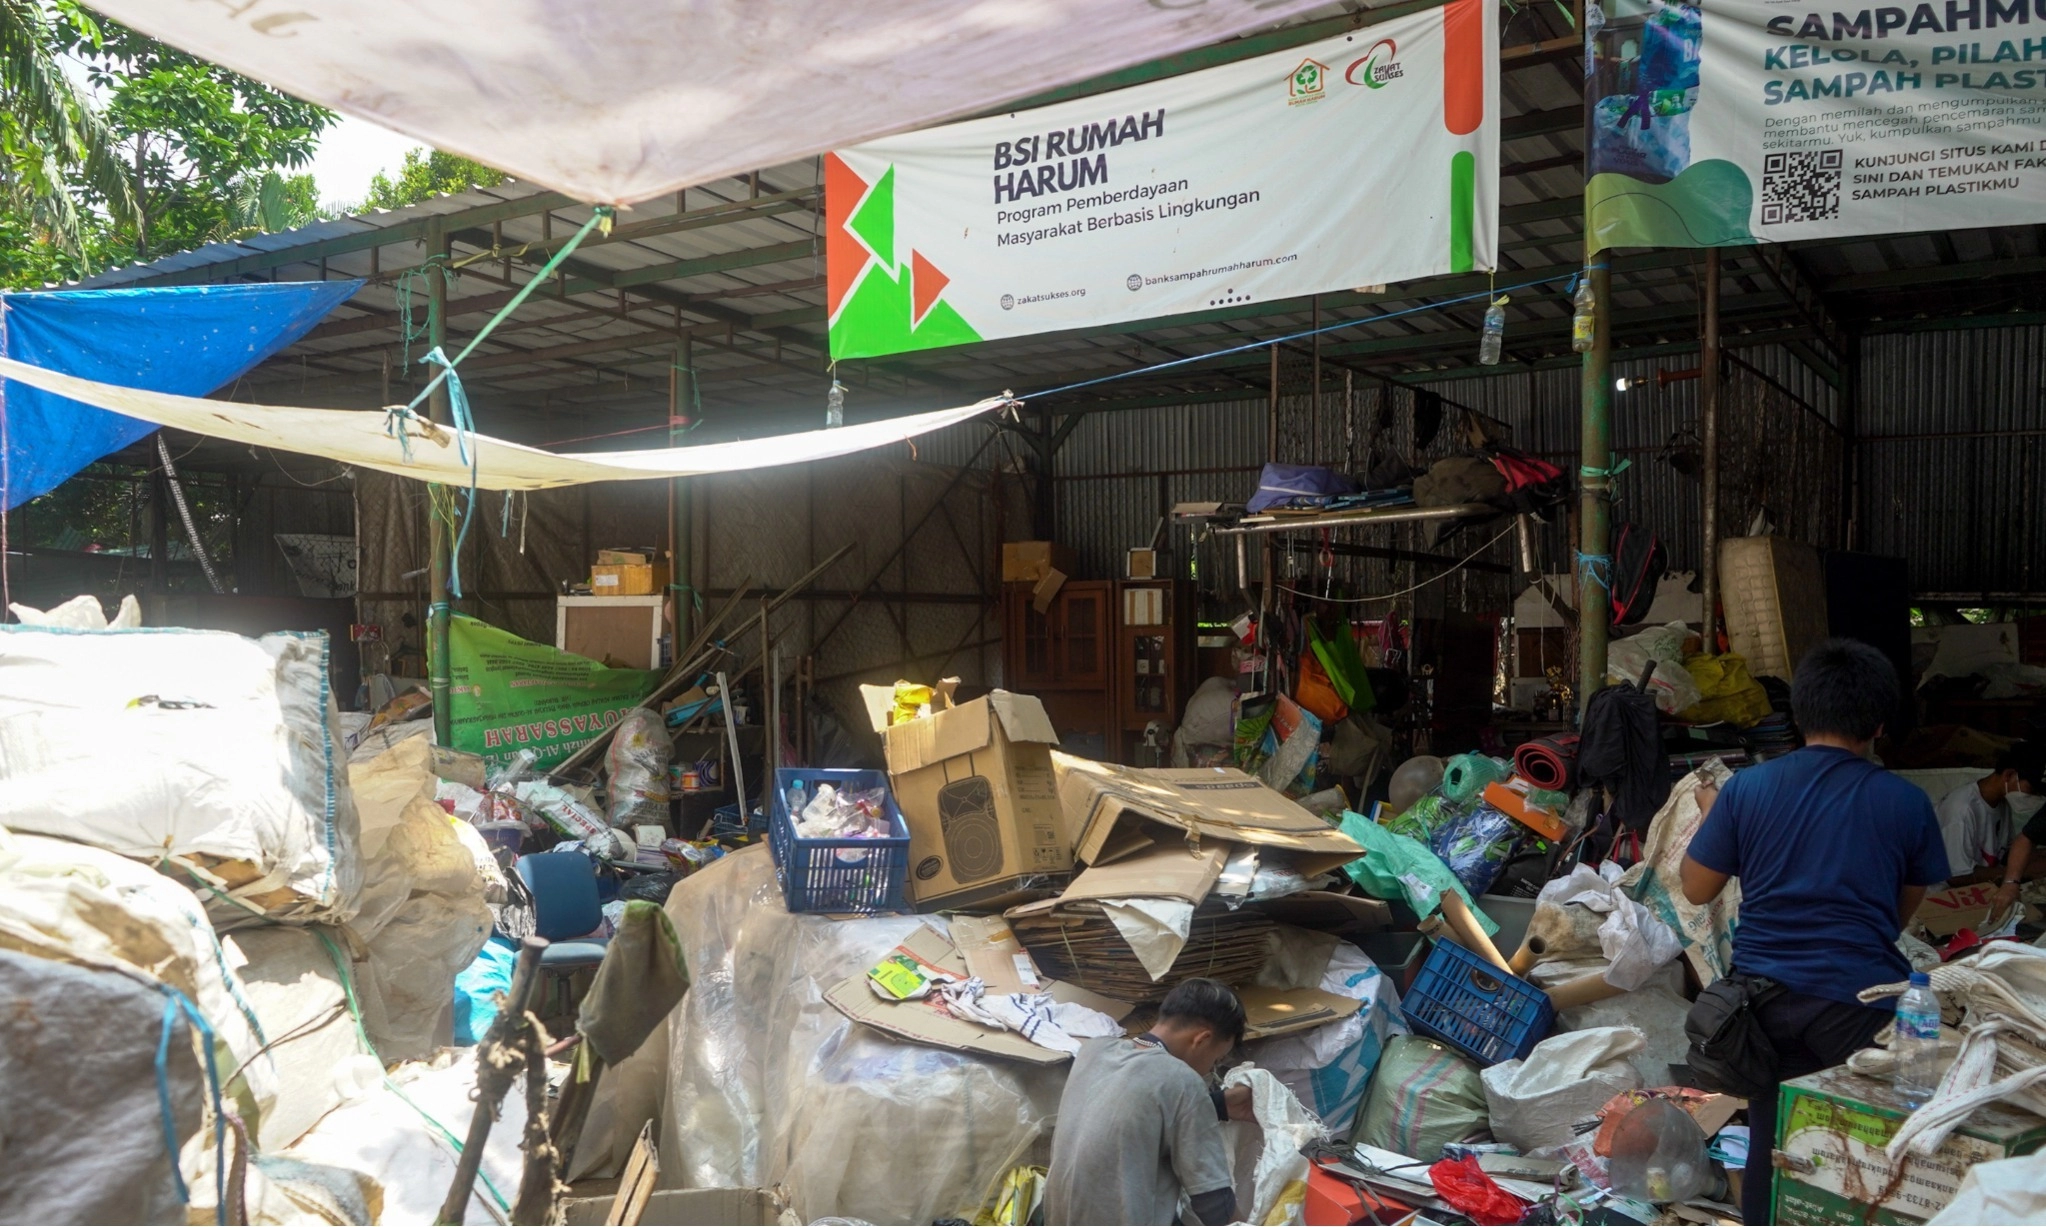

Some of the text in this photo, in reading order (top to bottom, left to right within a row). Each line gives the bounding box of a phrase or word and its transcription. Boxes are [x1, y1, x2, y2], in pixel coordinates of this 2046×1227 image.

[1764, 36, 2046, 70] KELOLA, PILAH
[1764, 70, 1921, 106] SAMPAH
[1764, 123, 1839, 139] membantu
[1843, 115, 1918, 132] mencegah
[1923, 107, 2015, 125] pencemaran
[1765, 97, 2037, 129] Dengan memilah dan mengumpulkan
[994, 108, 1165, 171] BSI RUMAH
[1762, 116, 2041, 150] sekitarmu. Yuk, kumpulkan sampahmu
[1855, 150, 1935, 169] KUNJUNGI
[1940, 144, 1986, 160] SITUS
[1991, 141, 2034, 155] KAMI
[993, 153, 1109, 204] HARUM
[1852, 176, 2020, 201] SAMPAH PLASTIKMU
[1853, 172, 1884, 184] SINI
[1888, 168, 1924, 183] DAN
[1928, 160, 2009, 180] TEMUKAN
[997, 177, 1189, 225] Program Pemberdayaan
[997, 189, 1261, 247] Masyarakat Berbasis Lingkungan
[1145, 253, 1298, 286] banksampahrumahharum.com
[1017, 287, 1087, 306] zakatsukses.org
[1927, 886, 1991, 909] Vit
